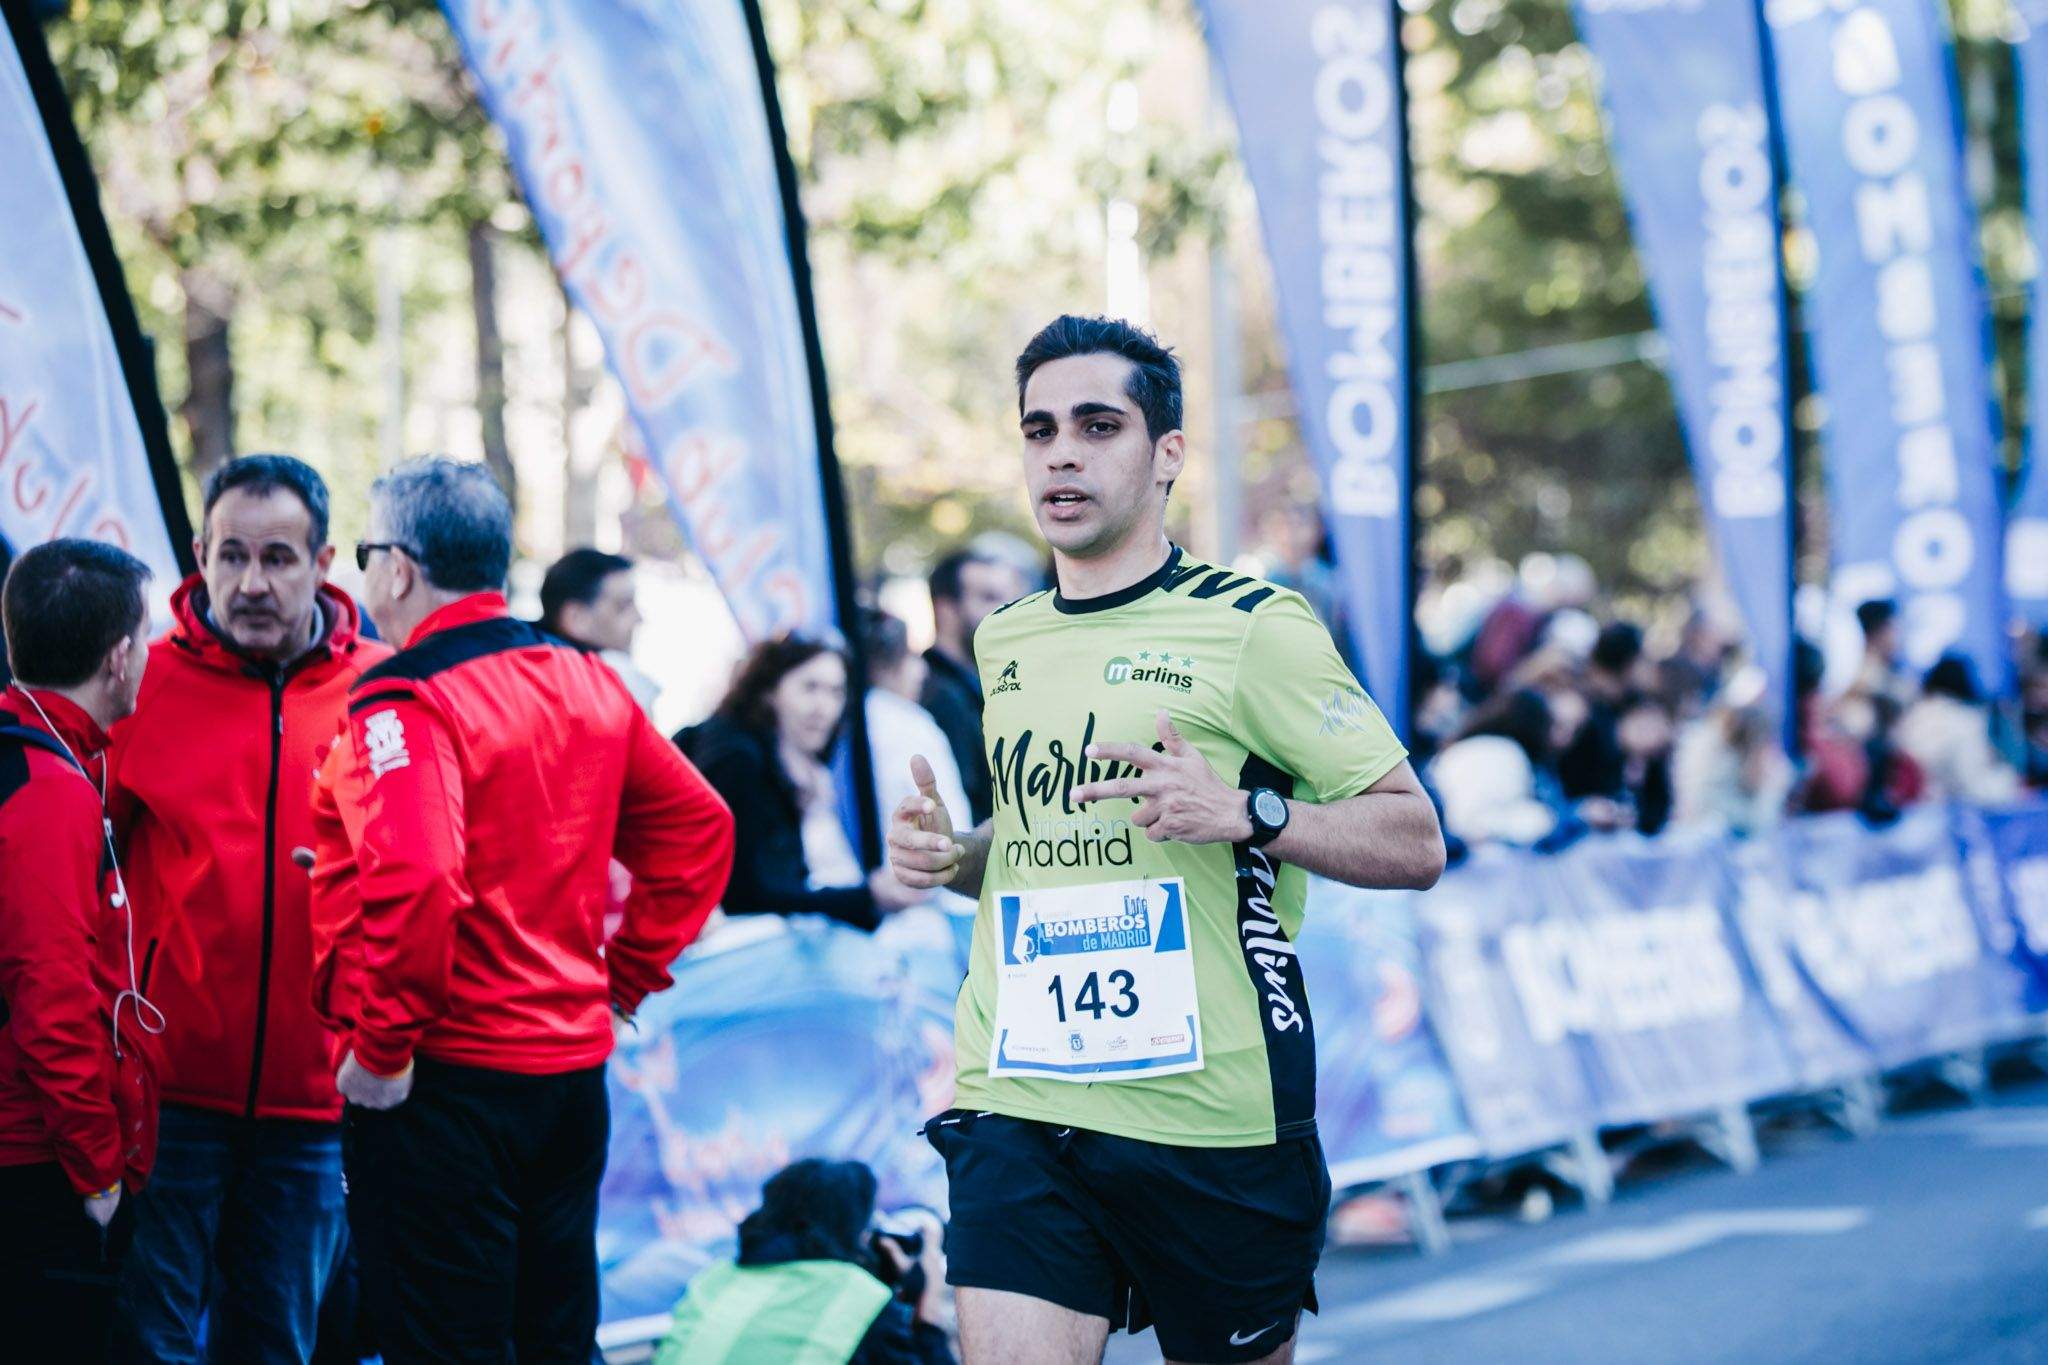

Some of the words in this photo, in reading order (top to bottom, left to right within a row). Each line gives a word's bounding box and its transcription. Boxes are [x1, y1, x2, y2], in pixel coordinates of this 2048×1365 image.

[1106, 661, 1193, 688] marlins
[992, 711, 1166, 835] Marl
[1005, 828, 1133, 868] madrid
[1044, 913, 1146, 938] BOMBEROS
[1082, 934, 1098, 951] de
[1100, 928, 1148, 949] MADRID
[1047, 969, 1140, 1023] 143
